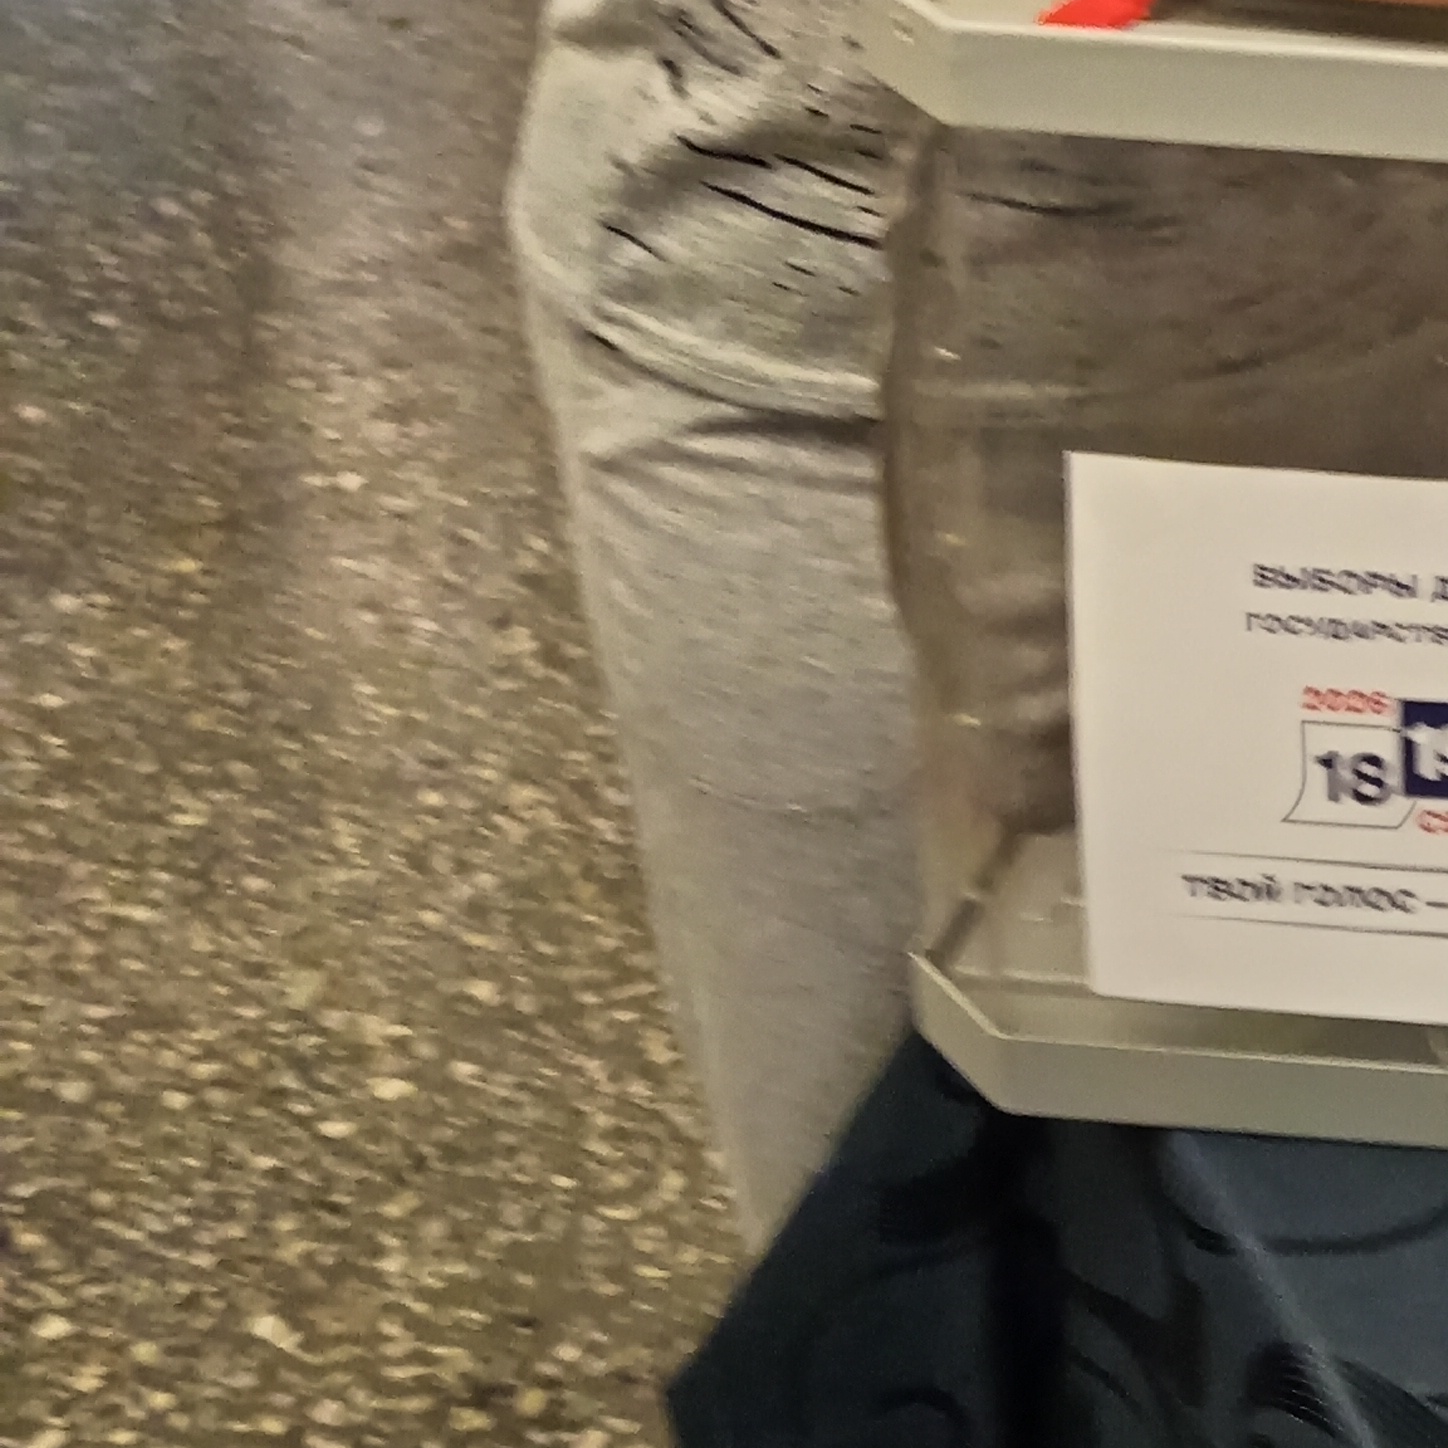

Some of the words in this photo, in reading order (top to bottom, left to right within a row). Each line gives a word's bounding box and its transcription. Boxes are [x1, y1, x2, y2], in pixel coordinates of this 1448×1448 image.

[1252, 562, 1418, 600] ВЫБОРЫ
[1313, 749, 1394, 808] 18
[1180, 873, 1282, 904] ТВОЙ
[1292, 881, 1420, 915] ГОЛОС
